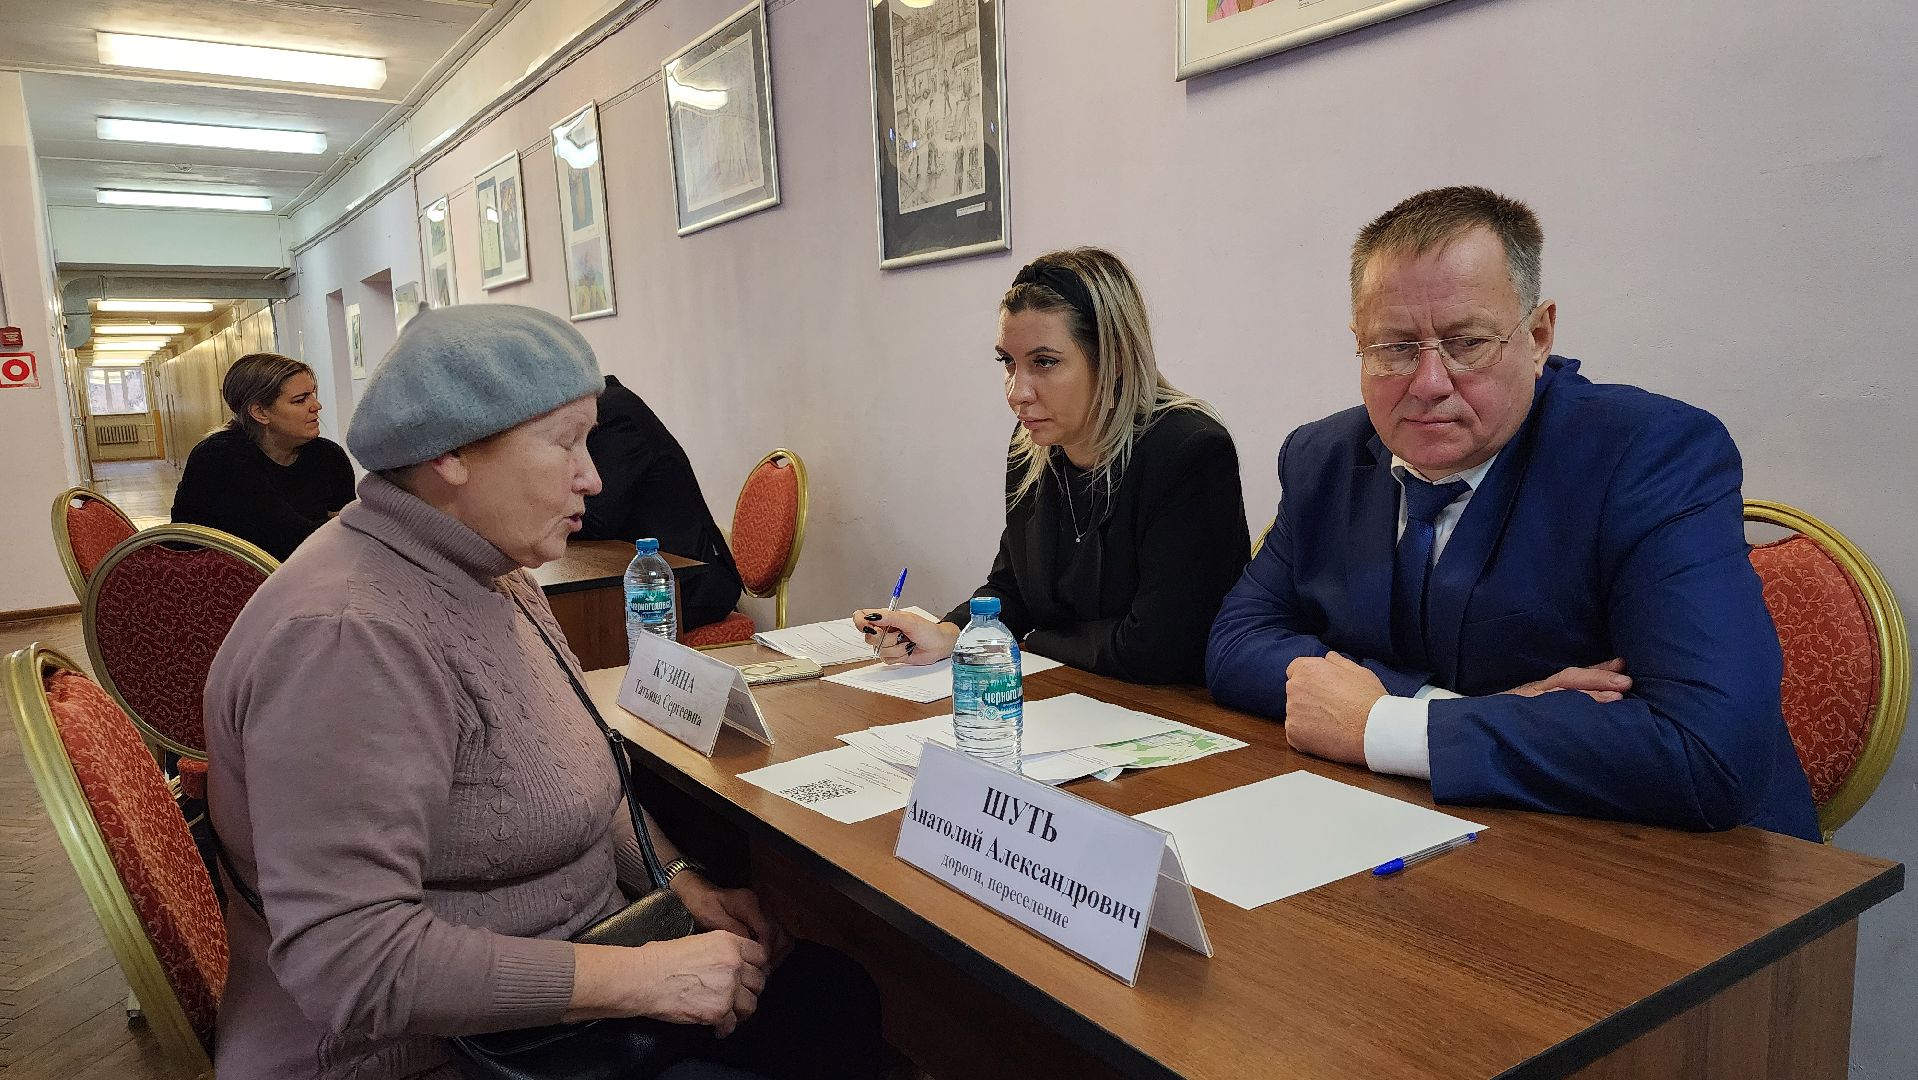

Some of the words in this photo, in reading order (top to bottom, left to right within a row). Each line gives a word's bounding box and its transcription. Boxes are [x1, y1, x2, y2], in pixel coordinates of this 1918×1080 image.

[634, 678, 662, 705] Татьяна
[662, 693, 703, 727] Сергеевна
[653, 658, 695, 694] КУЗИНА
[982, 786, 1058, 843] ШУТЬ
[908, 799, 983, 852] Анатолий
[986, 838, 1142, 929] Александрович
[940, 853, 985, 887] дороги,
[988, 876, 1070, 929] переселение
